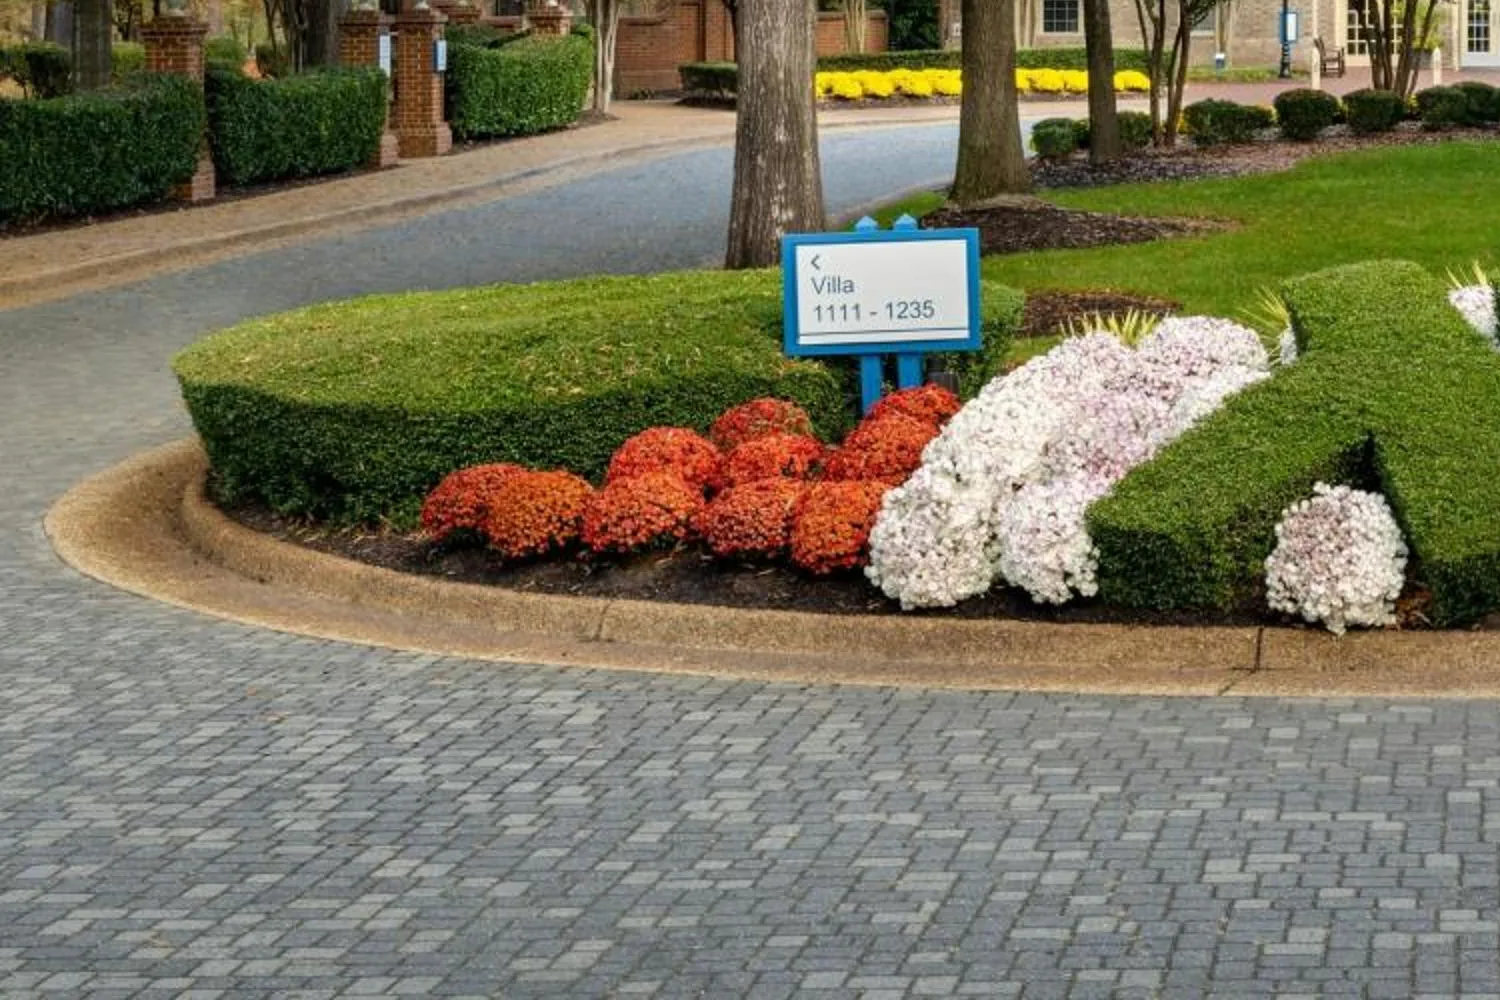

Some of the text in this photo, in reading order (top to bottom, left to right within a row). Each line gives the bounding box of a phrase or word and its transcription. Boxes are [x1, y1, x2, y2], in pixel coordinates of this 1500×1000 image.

[811, 275, 856, 295] Villa
[813, 302, 861, 323] 1111
[885, 299, 936, 321] 1235
